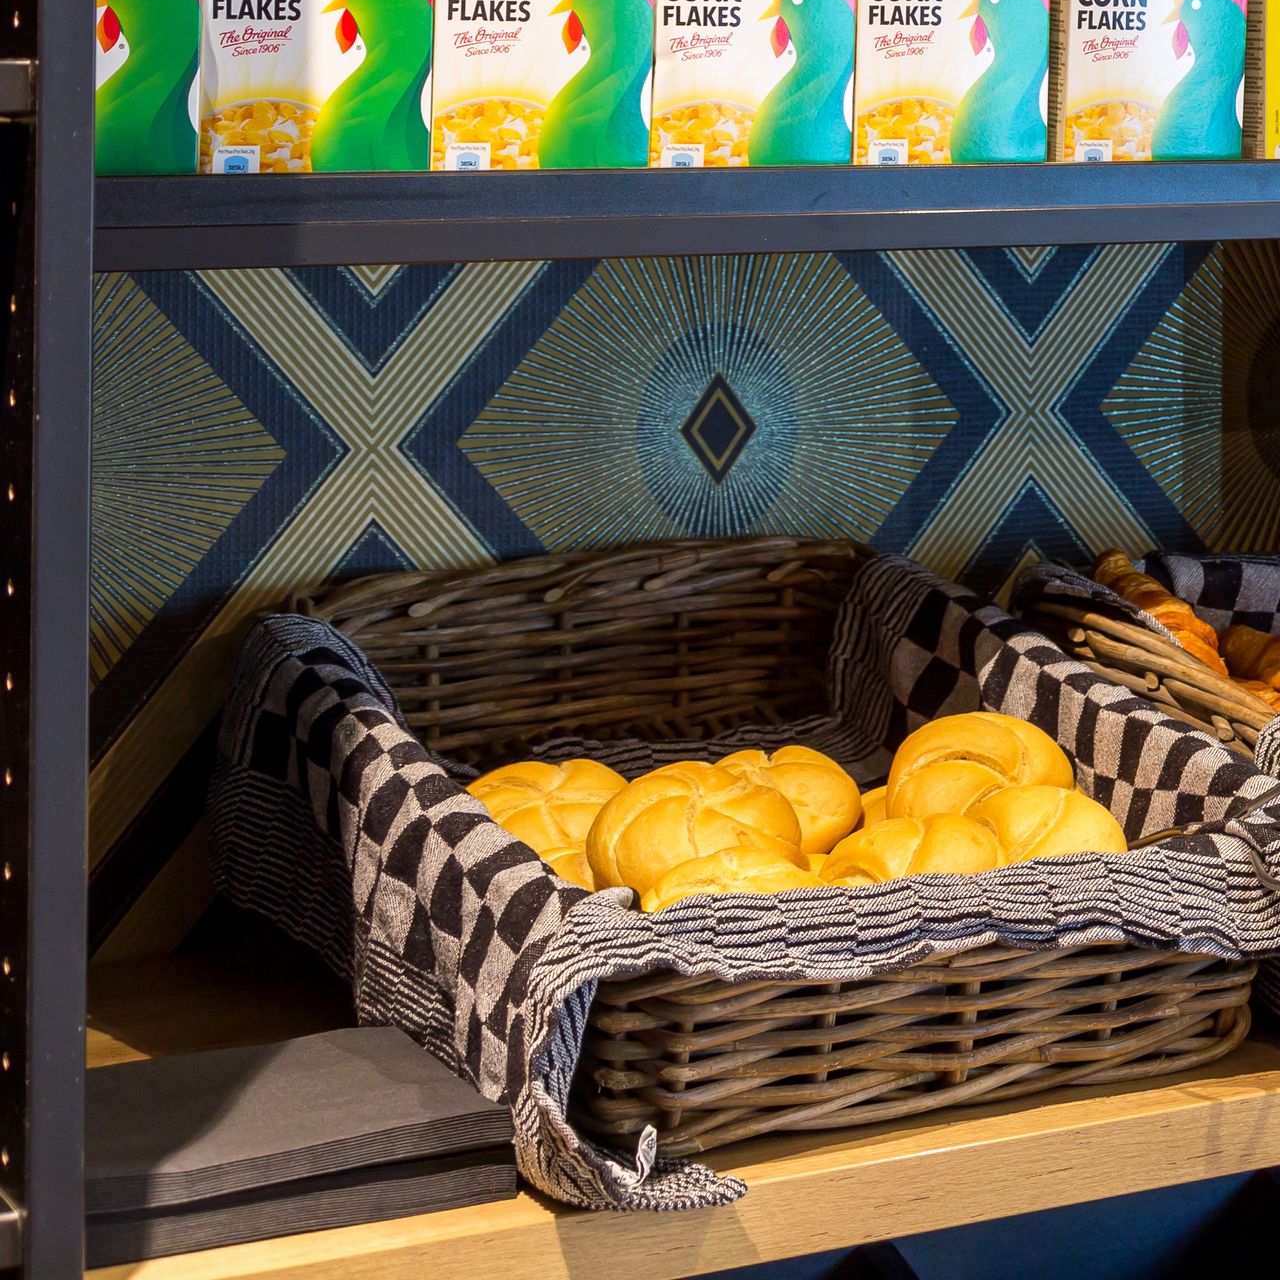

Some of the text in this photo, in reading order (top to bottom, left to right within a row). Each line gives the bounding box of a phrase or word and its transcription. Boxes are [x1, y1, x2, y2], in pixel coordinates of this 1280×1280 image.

[447, 0, 530, 22] FLAKES
[663, 5, 741, 28] FLAKES
[869, 5, 942, 26] FLAKES
[1078, 10, 1146, 32] FLAKES
[219, 25, 292, 47] The Original
[454, 27, 520, 47] The Original
[669, 32, 733, 51] The Original
[874, 31, 932, 50] The Original
[1082, 35, 1139, 53] The Original
[231, 46, 258, 57] Since
[465, 44, 490, 57] Since
[681, 49, 704, 61] Since
[884, 47, 908, 59] Since
[1092, 51, 1113, 62] Since
